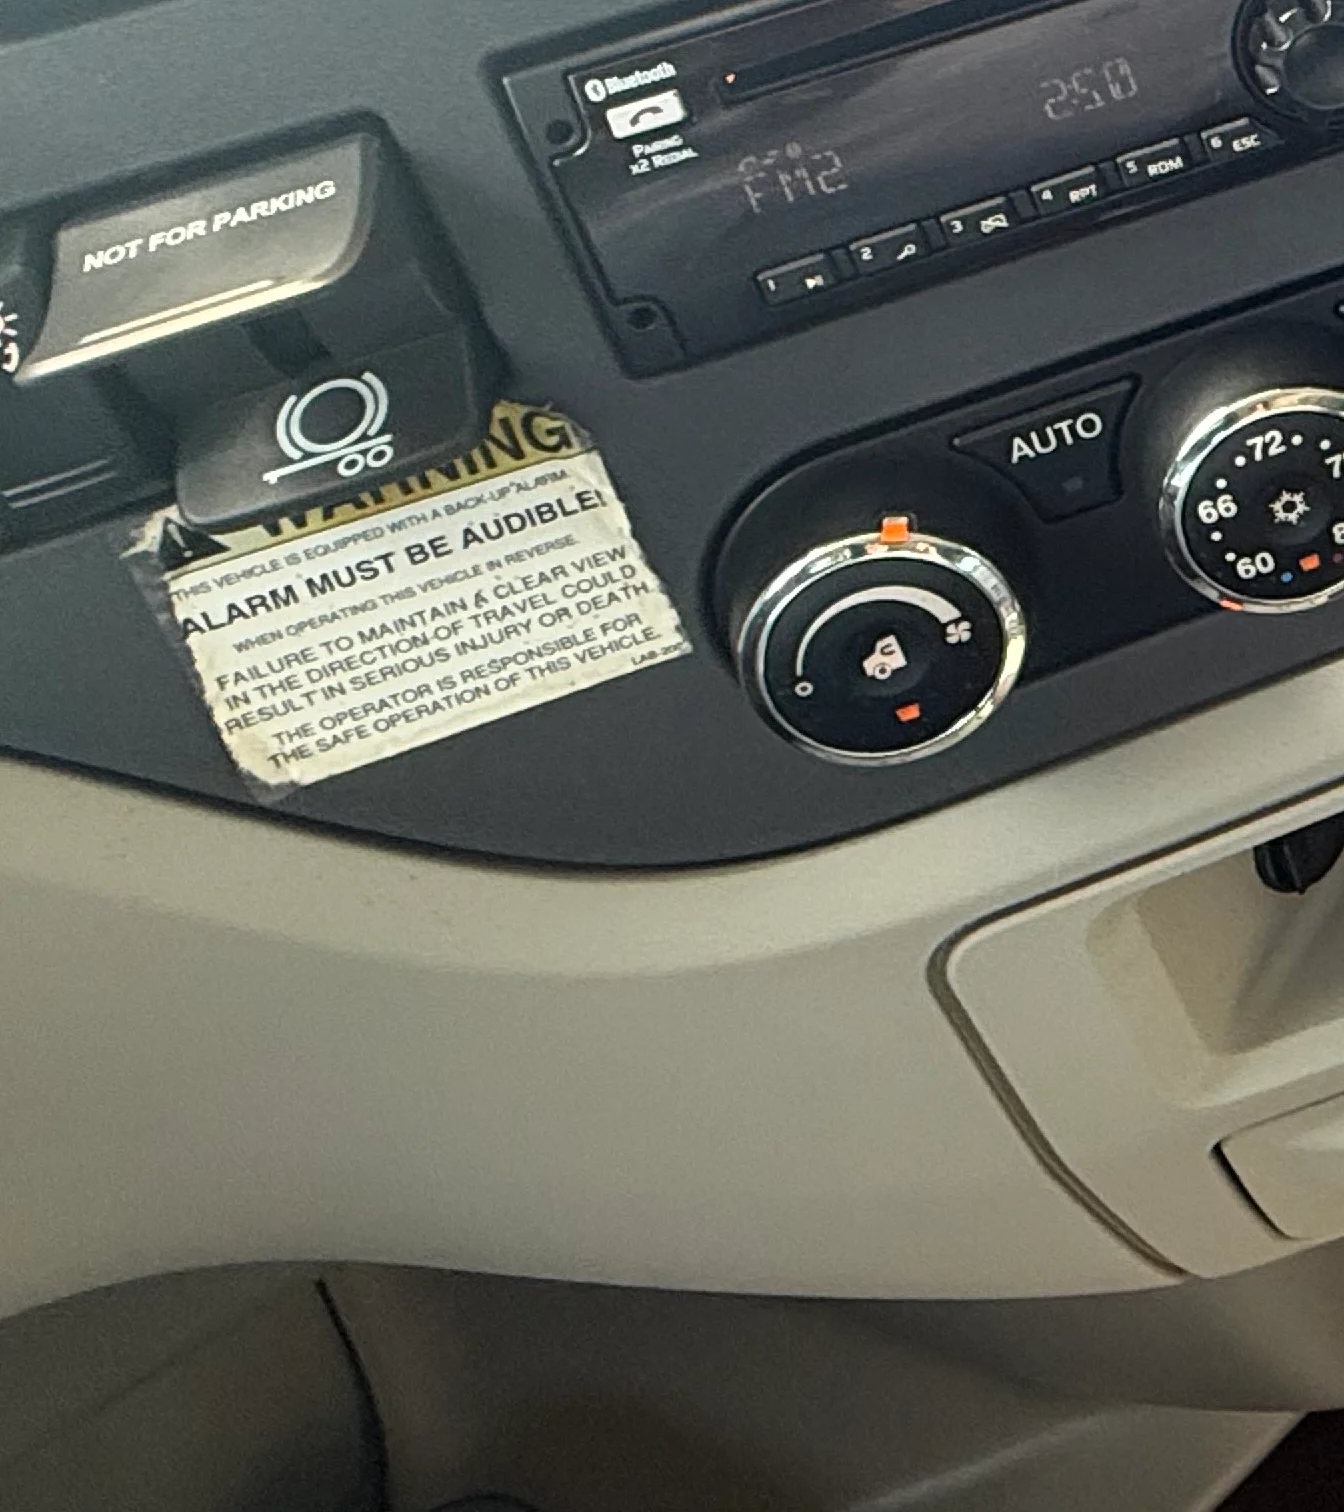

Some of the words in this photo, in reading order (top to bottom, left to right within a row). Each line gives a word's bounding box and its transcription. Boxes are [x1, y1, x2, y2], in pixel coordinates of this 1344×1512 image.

[1232, 133, 1262, 153] ESC
[82, 239, 145, 272] NOT
[147, 218, 208, 253] FOR
[211, 180, 338, 233] PARKING
[950, 220, 964, 234] 3
[1068, 183, 1099, 204] RPT
[860, 247, 873, 261] 2
[1009, 411, 1103, 465] AUTO
[1246, 430, 1287, 463] 72
[1198, 493, 1239, 526] 66
[181, 583, 301, 638] ALARM
[304, 551, 397, 599] MUST
[404, 535, 454, 567] BE
[212, 558, 284, 590] VEHICLE
[302, 525, 384, 561] EQUIPPED
[387, 511, 429, 536] WITH
[1235, 551, 1276, 581] 60
[215, 646, 319, 692] FAILURE
[319, 635, 355, 656] TO
[357, 597, 468, 645] MAINTAIN
[473, 588, 490, 610] A
[492, 564, 570, 600] CLEAR
[571, 544, 627, 574] VIEW
[224, 690, 252, 712] IN
[252, 673, 303, 701] THE
[305, 631, 430, 684] DIRECTION
[433, 620, 465, 642] OF
[468, 591, 558, 629] TRAVEL
[561, 563, 637, 600] COULD
[232, 628, 284, 654] WHEN
[285, 598, 379, 637] OPERATING
[379, 584, 418, 606] THIS
[418, 563, 483, 593] VEHICLE
[223, 688, 320, 736] RESULT
[321, 681, 347, 701] IN
[349, 646, 452, 692] SERIOUS
[455, 618, 533, 657] INJURY
[537, 606, 573, 628] OR
[576, 580, 651, 616] DEATH
[271, 721, 317, 746] THE
[318, 682, 434, 731] OPERATOR
[436, 674, 458, 691] IS
[459, 627, 597, 684] RESPONSIBLE
[599, 612, 644, 637] FOR
[267, 742, 314, 769] THE
[315, 724, 372, 754] SAFE
[373, 682, 492, 734] OPERATION
[493, 672, 523, 693] OF
[524, 655, 572, 681] THIS
